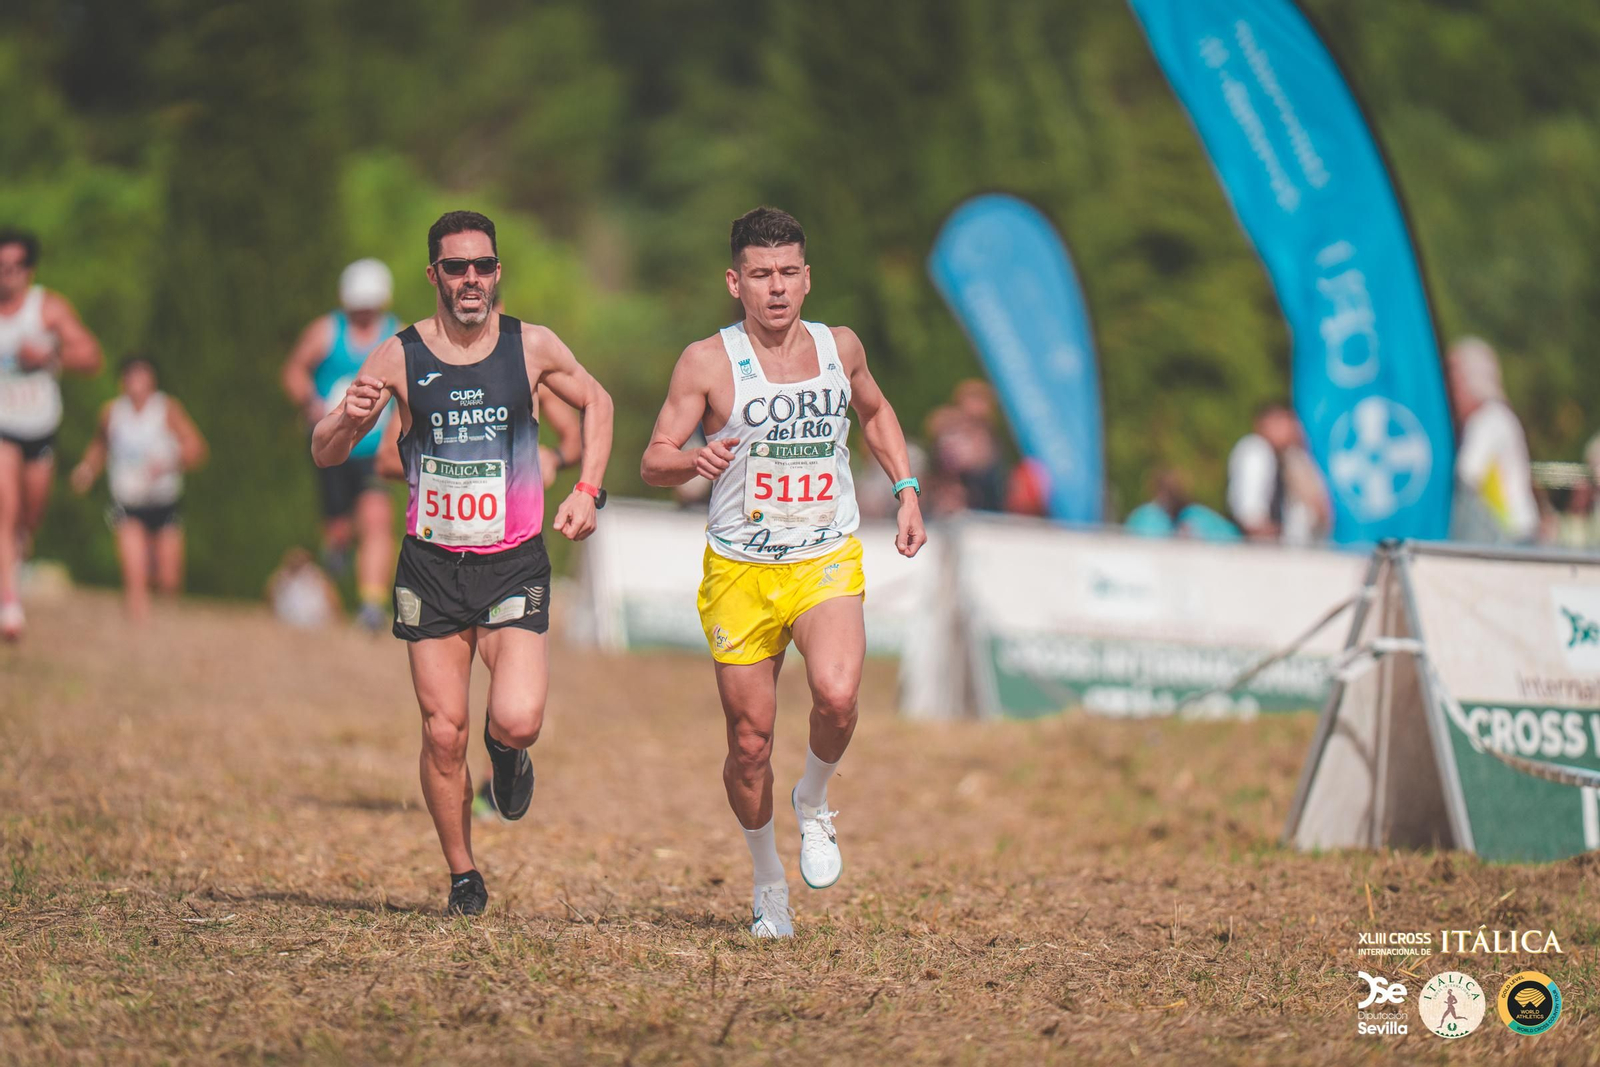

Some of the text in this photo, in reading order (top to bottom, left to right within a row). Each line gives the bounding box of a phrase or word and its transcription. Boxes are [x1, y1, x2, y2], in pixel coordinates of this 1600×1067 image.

[450, 388, 485, 401] CUPA
[431, 406, 508, 427] O BARCO
[767, 417, 832, 441] del Río
[776, 445, 819, 456] ITÁLICA
[441, 463, 479, 476] ITÁLICA
[754, 472, 834, 503] 5112
[425, 489, 498, 521] 5100
[1466, 706, 1588, 758] CROSS
